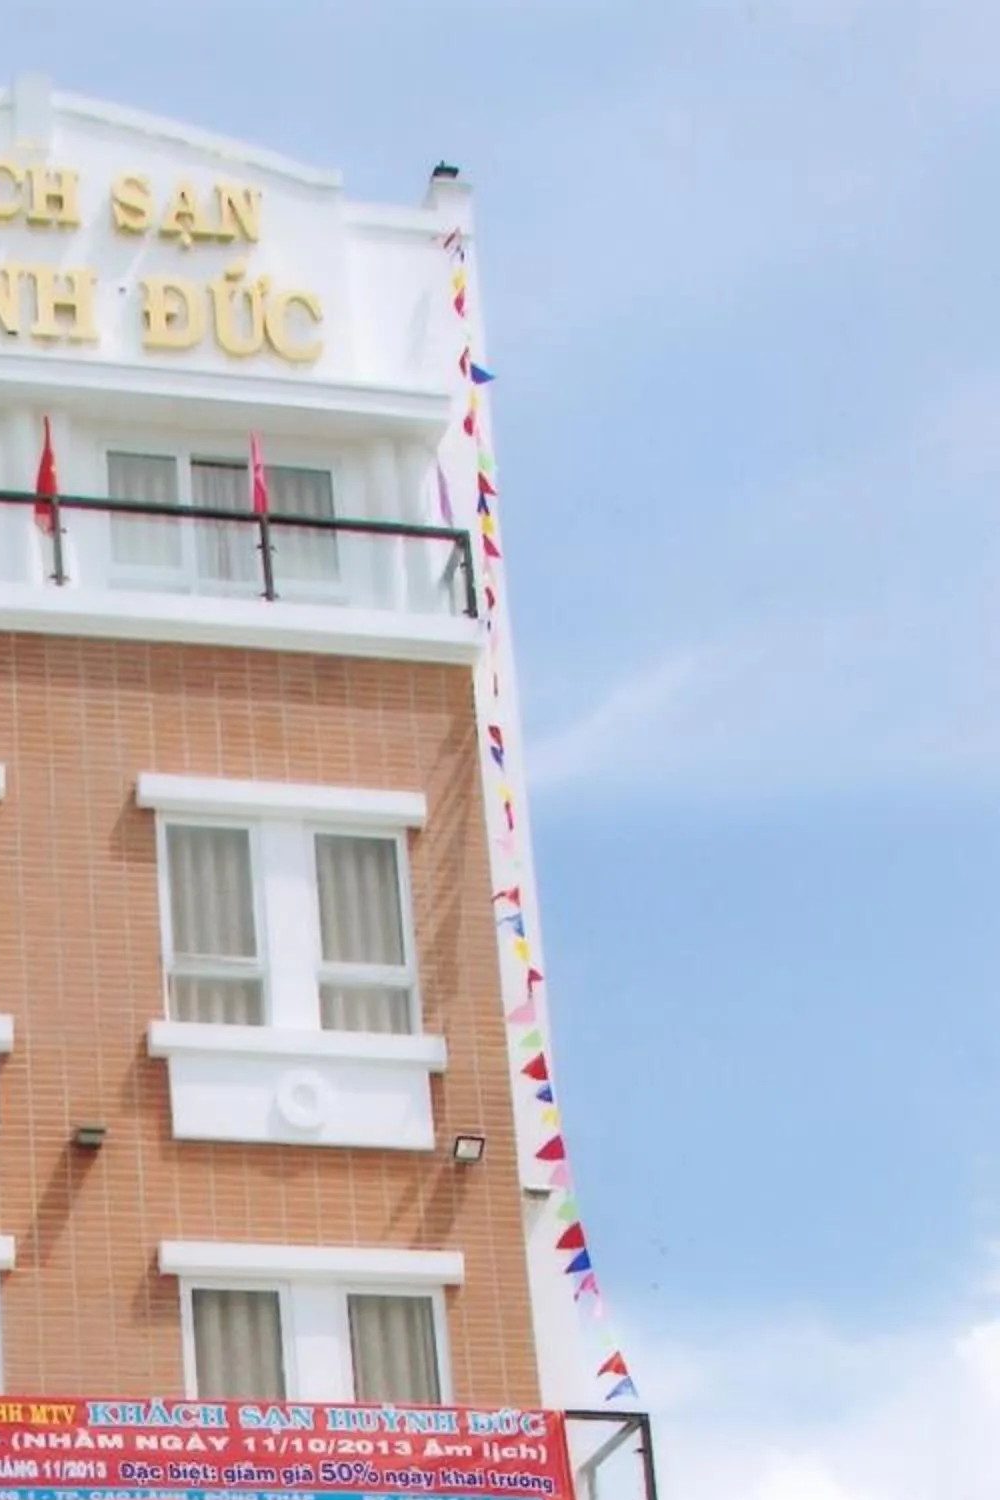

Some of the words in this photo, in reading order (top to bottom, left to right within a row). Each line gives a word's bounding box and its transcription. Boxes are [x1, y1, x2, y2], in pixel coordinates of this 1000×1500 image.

[111, 173, 262, 250] SẠN
[141, 258, 324, 365] ĐỨC
[30, 1403, 76, 1424] MTV
[87, 1398, 229, 1428] KHÁCH
[239, 1404, 315, 1434] SẠN
[327, 1405, 458, 1434] HUỲNH
[136, 1432, 230, 1451] NGÀY
[243, 1436, 412, 1457] 11/10/2013
[423, 1438, 473, 1457] Âm
[483, 1441, 548, 1464] lịch)
[42, 1460, 108, 1480] 11/2013
[320, 1461, 380, 1484] 50%
[440, 1470, 485, 1487] khai
